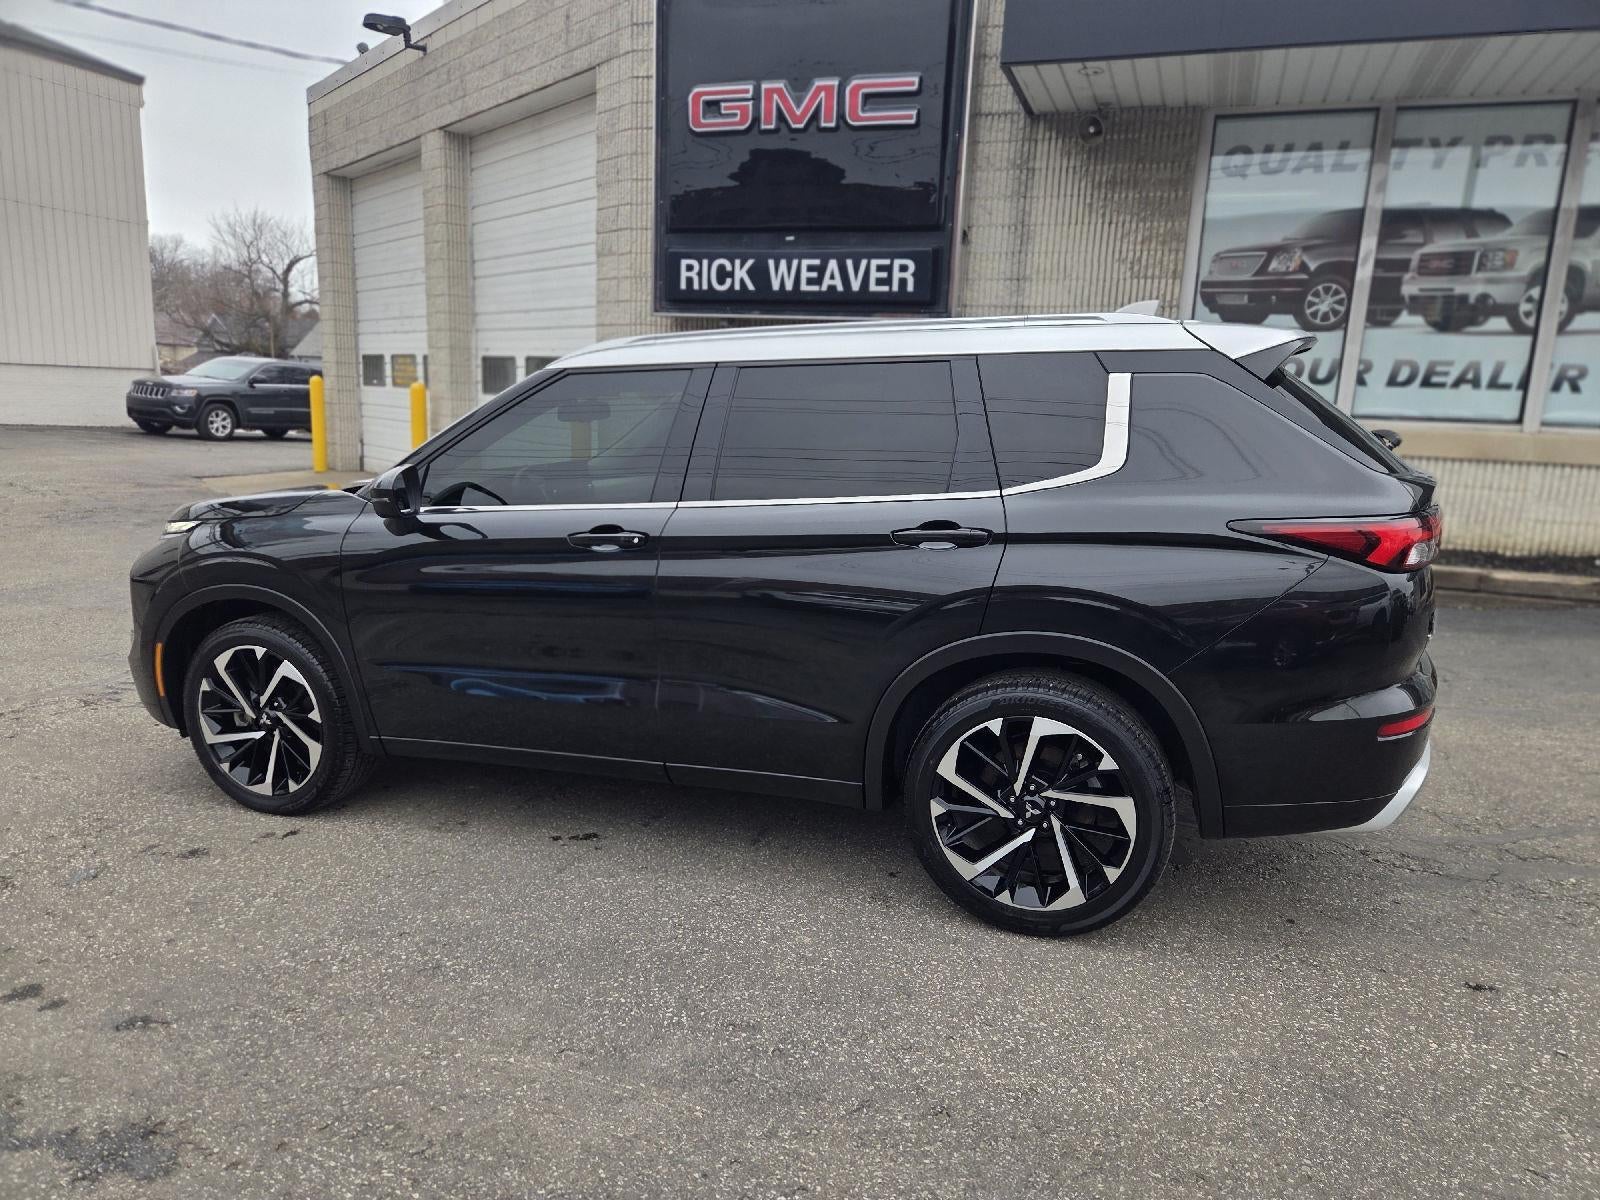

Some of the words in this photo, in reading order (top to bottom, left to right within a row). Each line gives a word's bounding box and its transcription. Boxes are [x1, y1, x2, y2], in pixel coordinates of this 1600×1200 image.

[688, 73, 920, 132] GMC
[1220, 136, 1463, 180] QUALTY
[679, 258, 755, 291] RICK
[768, 258, 916, 292] WEAVER
[1385, 358, 1590, 394] DEALR
